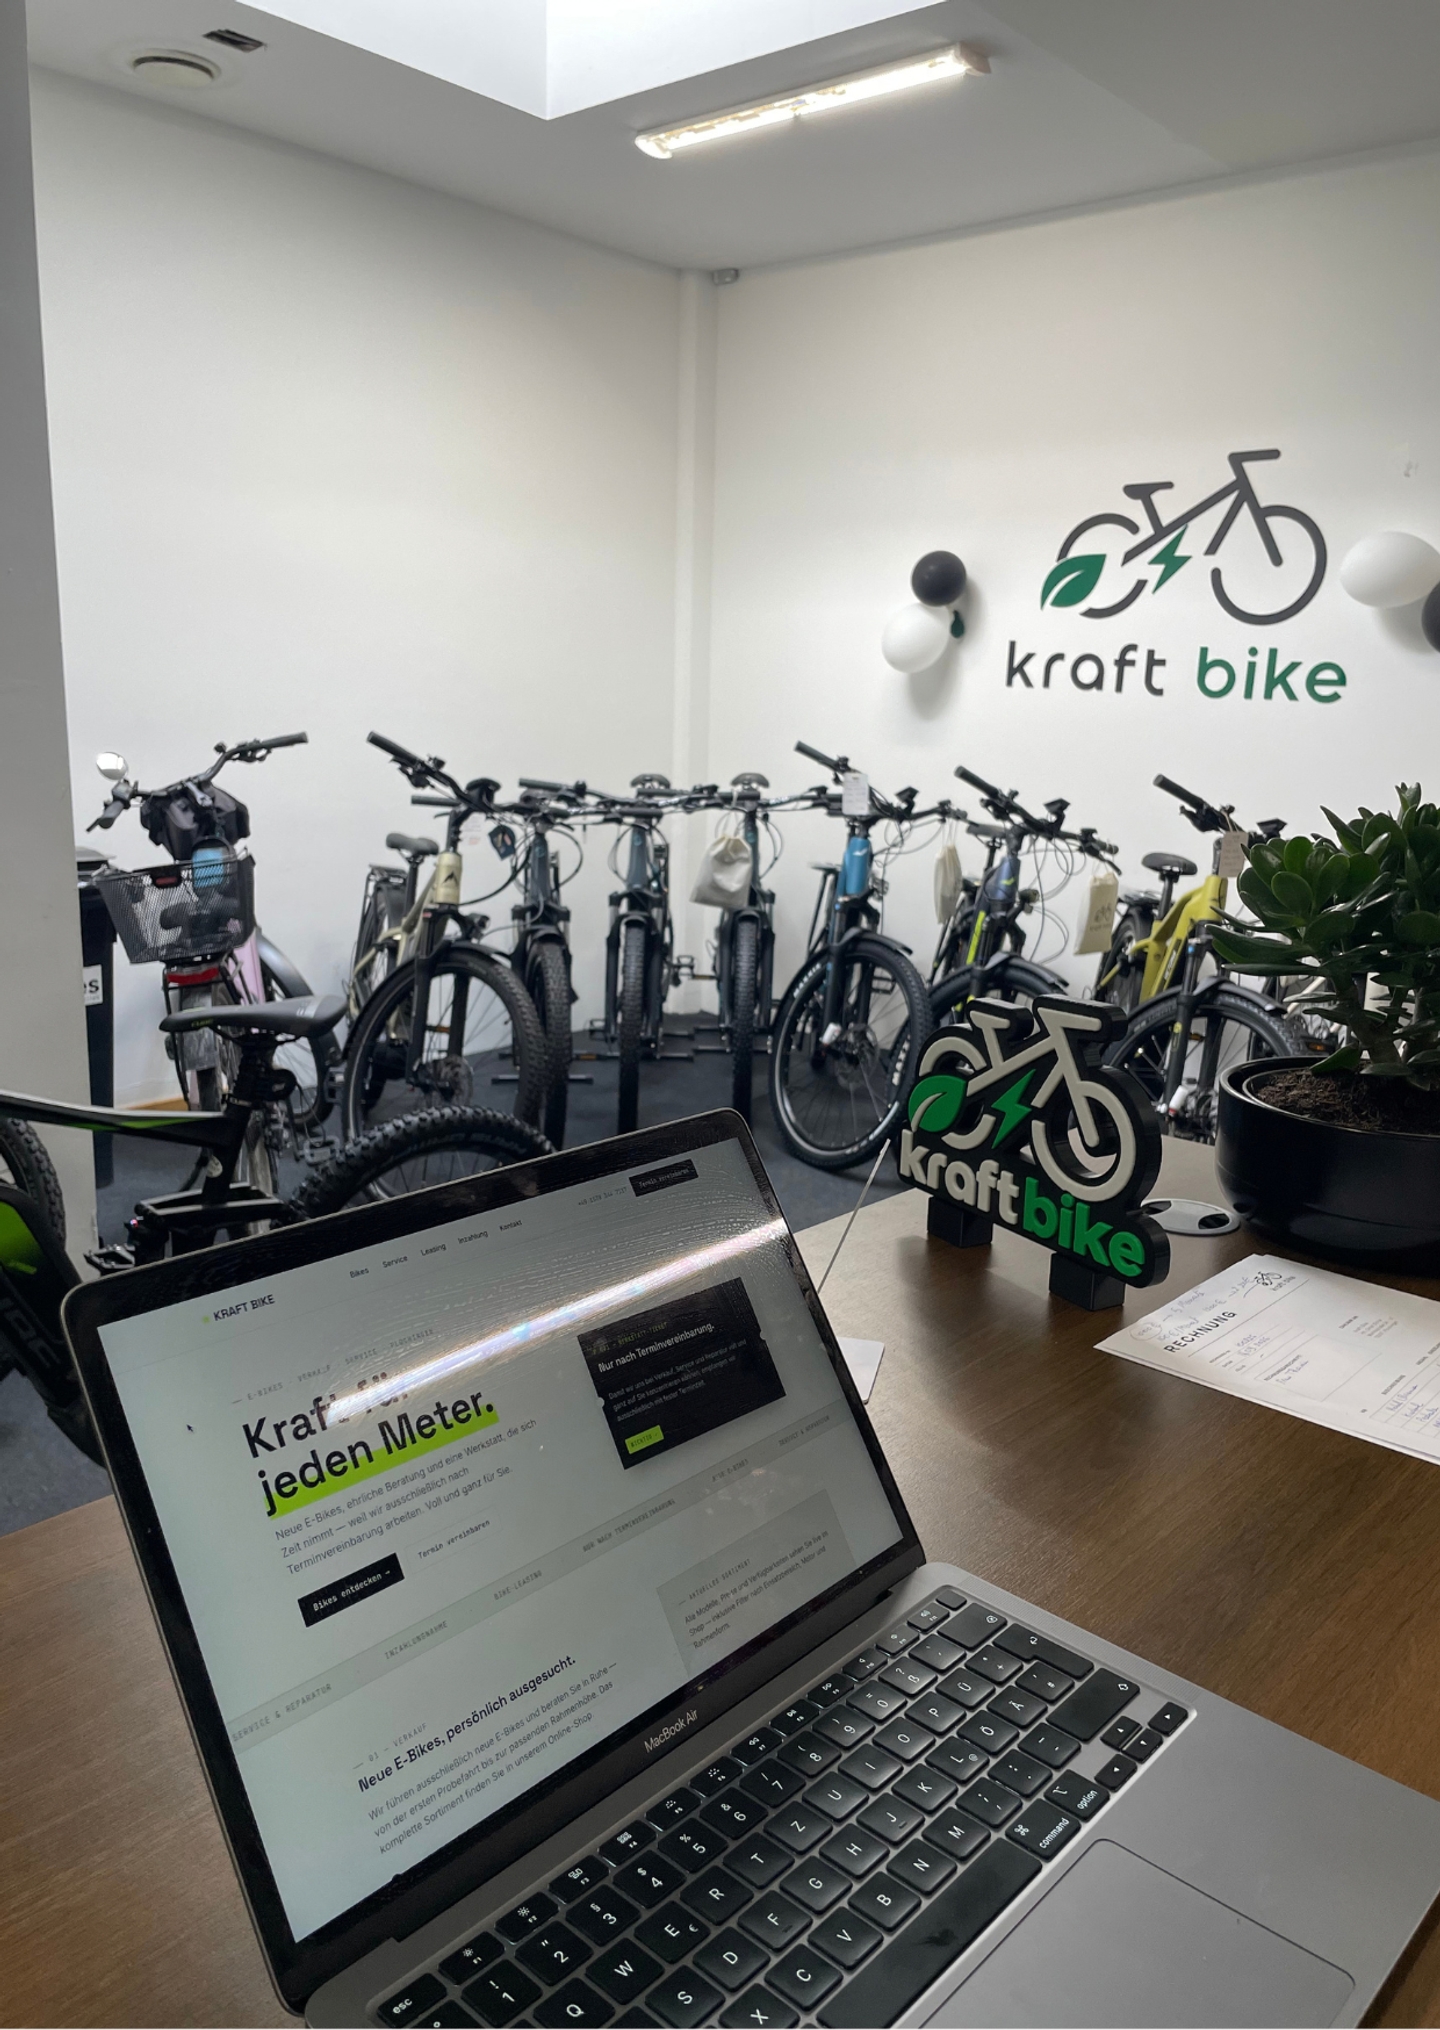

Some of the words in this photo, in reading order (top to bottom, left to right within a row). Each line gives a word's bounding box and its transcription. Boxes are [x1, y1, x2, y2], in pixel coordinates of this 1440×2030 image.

[1006, 640, 1166, 696] kraft
[1196, 646, 1347, 703] bike
[350, 1267, 369, 1279] Bikes
[382, 1255, 408, 1268] Service
[420, 1243, 447, 1256] Leasing
[457, 1230, 489, 1245] Inzahlung
[499, 1219, 523, 1232] Kontakt
[213, 1301, 248, 1321] KRAFT
[250, 1294, 275, 1310] BIKE
[1163, 1311, 1238, 1353] RECHNUNG
[597, 1361, 614, 1374] Nur
[615, 1353, 637, 1368] nach
[247, 1382, 283, 1400] E-BIKES
[258, 1440, 374, 1517] jeden
[378, 1392, 494, 1455] Meter.
[275, 1523, 303, 1541] Neue
[304, 1506, 345, 1529] E-Bikes,
[347, 1487, 384, 1509] ehrliche
[385, 1468, 426, 1492] Beratung
[427, 1460, 444, 1474] und
[445, 1452, 463, 1466] eine
[464, 1434, 507, 1456] Werkstatt,
[506, 1427, 519, 1438] die
[521, 1419, 537, 1432] sich
[281, 1543, 302, 1559] Zeit
[303, 1527, 334, 1548] nimmt
[347, 1513, 368, 1528] weil
[369, 1503, 383, 1517] wir
[385, 1476, 448, 1511] ausschließlich
[448, 1467, 469, 1482] nach
[287, 1525, 384, 1574] Terminvereinbarung
[385, 1507, 424, 1530] arbeiten.
[425, 1497, 442, 1510] Voll
[443, 1489, 460, 1503] und
[462, 1480, 482, 1496] ganz
[483, 1473, 495, 1484] für
[496, 1466, 513, 1478] Sie.
[418, 1542, 443, 1559] Termin
[447, 1520, 490, 1545] vereinbaren
[493, 1570, 542, 1600] BIKE-LEASING
[312, 1595, 338, 1612] Bikes
[341, 1573, 382, 1598] entdecken
[689, 1624, 705, 1637] Shop
[907, 1674, 920, 1684] ß
[957, 1681, 971, 1692] Ü
[232, 1716, 270, 1741] SERVICE
[275, 1710, 281, 1719] &
[286, 1683, 332, 1713] REPARATUR
[928, 1708, 939, 1717] P
[1008, 1700, 1024, 1711] Ä
[358, 1765, 393, 1793] Neue
[394, 1736, 447, 1773] E-Bikes,
[446, 1695, 508, 1743] persönlich
[508, 1655, 576, 1703] ausgesucht.
[643, 1718, 685, 1753] MacBook
[686, 1709, 698, 1725] Air
[843, 1725, 856, 1734] 9
[980, 1725, 994, 1736] Ö
[392, 1722, 428, 1748] VERKAUF
[897, 1733, 910, 1743] O
[367, 1803, 384, 1821] Wir
[385, 1787, 416, 1811] führen
[416, 1750, 474, 1792] ausschließlich
[474, 1737, 495, 1755] neue
[495, 1721, 525, 1743] E-Bikes
[525, 1708, 542, 1723] und
[541, 1691, 570, 1714] beraten
[569, 1683, 582, 1696] Sie
[581, 1678, 589, 1689] in
[589, 1667, 609, 1685] Ruhe
[374, 1823, 392, 1838] von
[392, 1810, 409, 1827] der
[410, 1793, 437, 1816] ersten
[437, 1763, 481, 1798] Probefahrt
[481, 1756, 494, 1771] bis
[494, 1749, 509, 1763] zur
[508, 1723, 549, 1756] passenden
[598, 1680, 613, 1696] Das
[809, 1752, 822, 1762] 8
[950, 1755, 964, 1763] L
[378, 1821, 424, 1855] komplette
[423, 1794, 466, 1827] Sortiment
[465, 1778, 492, 1800] finden
[491, 1767, 505, 1783] Sie
[505, 1763, 514, 1774] in
[514, 1742, 548, 1768] unserem
[548, 1711, 595, 1746] Online-Shop.
[771, 1780, 784, 1790] 7
[917, 1781, 932, 1793] K
[827, 1789, 842, 1800] U
[1077, 1790, 1098, 1809] option
[733, 1811, 746, 1821] 6
[886, 1811, 897, 1822] J
[790, 1820, 806, 1832] Z
[948, 1825, 966, 1839] M
[1039, 1817, 1070, 1848] command
[692, 1842, 706, 1854] 5
[845, 1842, 862, 1856] H
[750, 1853, 764, 1864] T
[913, 1858, 930, 1871] N
[651, 1877, 663, 1888] 4
[808, 1877, 823, 1889] G
[708, 1887, 724, 1900] R
[876, 1893, 892, 1906] B
[602, 1913, 617, 1925] 3
[767, 1912, 779, 1926] F
[664, 1923, 680, 1937] E
[836, 1928, 852, 1942] V
[553, 1951, 569, 1963] 2
[722, 1951, 738, 1964] D
[613, 1960, 634, 1977] W
[796, 1968, 812, 1983] C
[502, 1992, 515, 2003] 1
[677, 1991, 693, 2005] S
[393, 1999, 412, 2014] esc
[566, 2004, 585, 2018] Q
[750, 2008, 769, 2025] X
